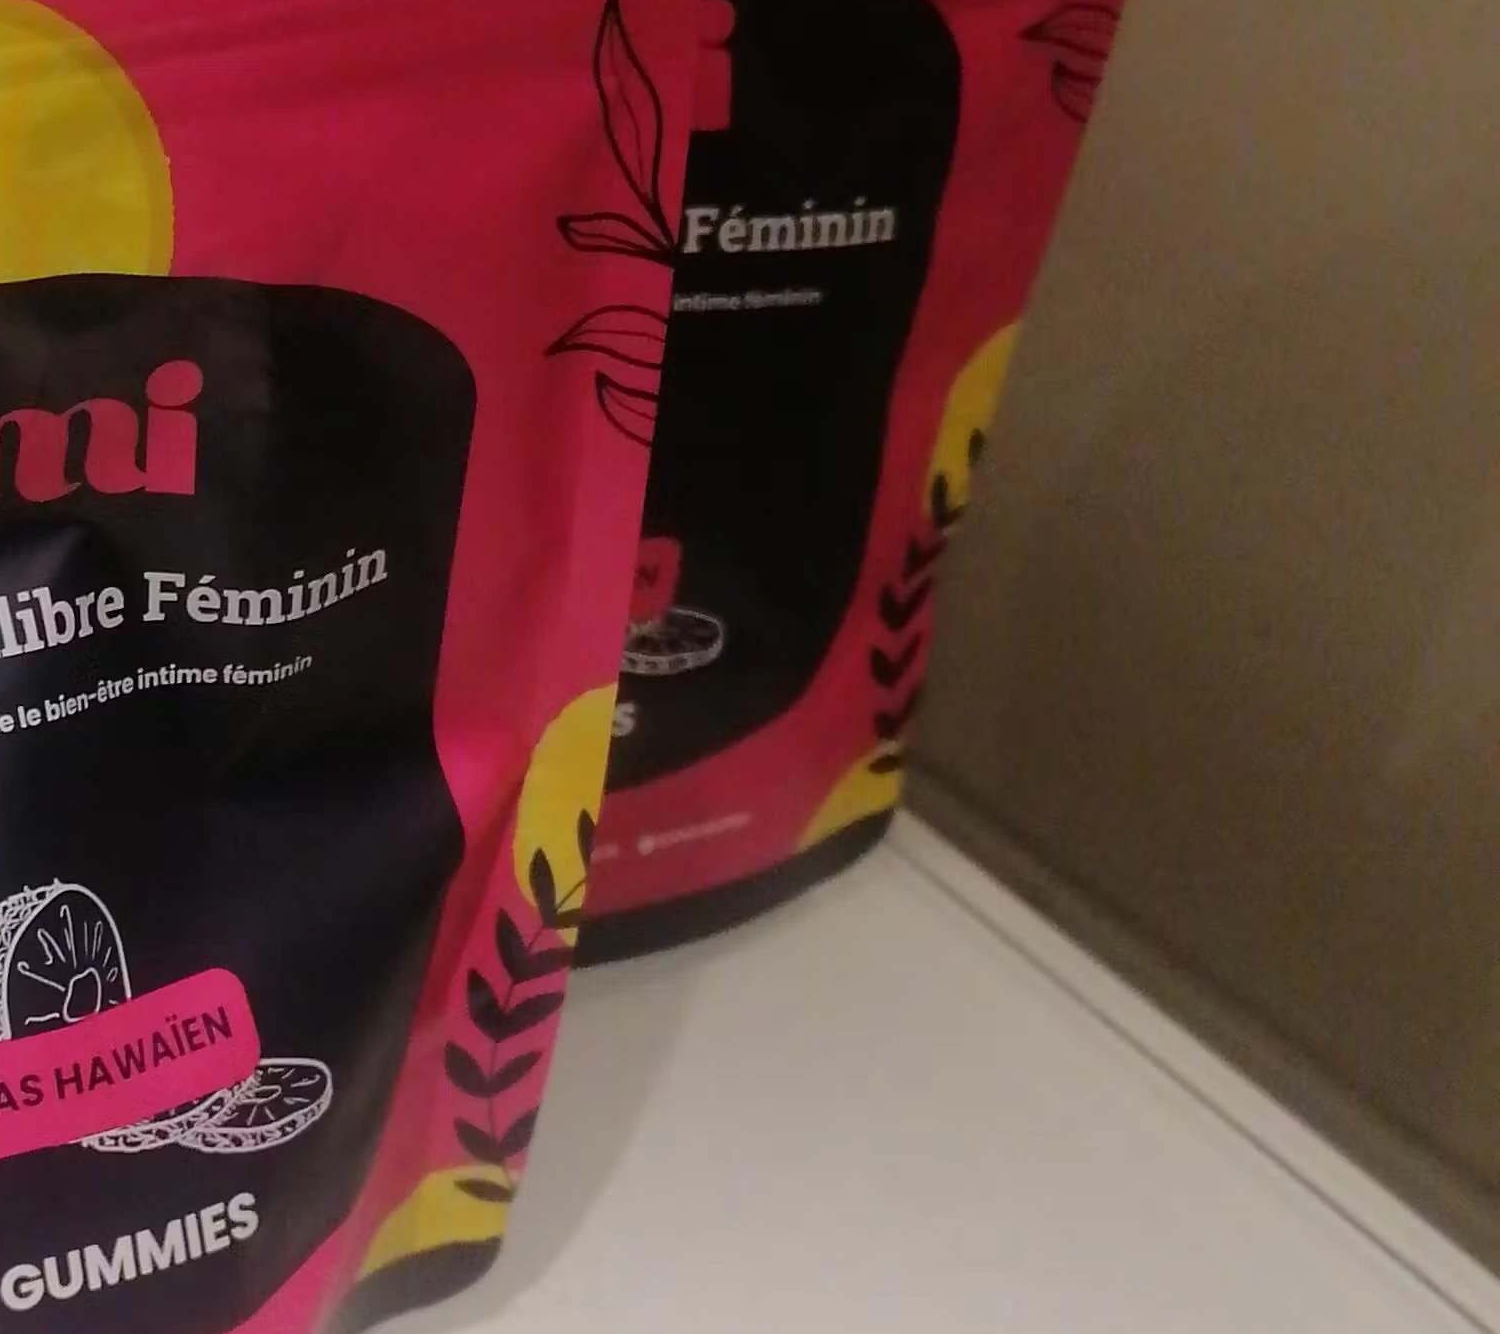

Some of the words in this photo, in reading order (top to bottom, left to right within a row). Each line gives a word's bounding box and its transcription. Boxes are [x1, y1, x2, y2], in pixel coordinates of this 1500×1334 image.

[683, 196, 895, 254] Féminin
[143, 547, 388, 627] Féminin
[17, 704, 42, 730] le
[45, 676, 134, 723] bien-être
[138, 663, 218, 690] intime
[223, 653, 313, 686] féminin
[54, 1005, 234, 1101] HAWAÏEN
[0, 1192, 260, 1312] GUMMIES
